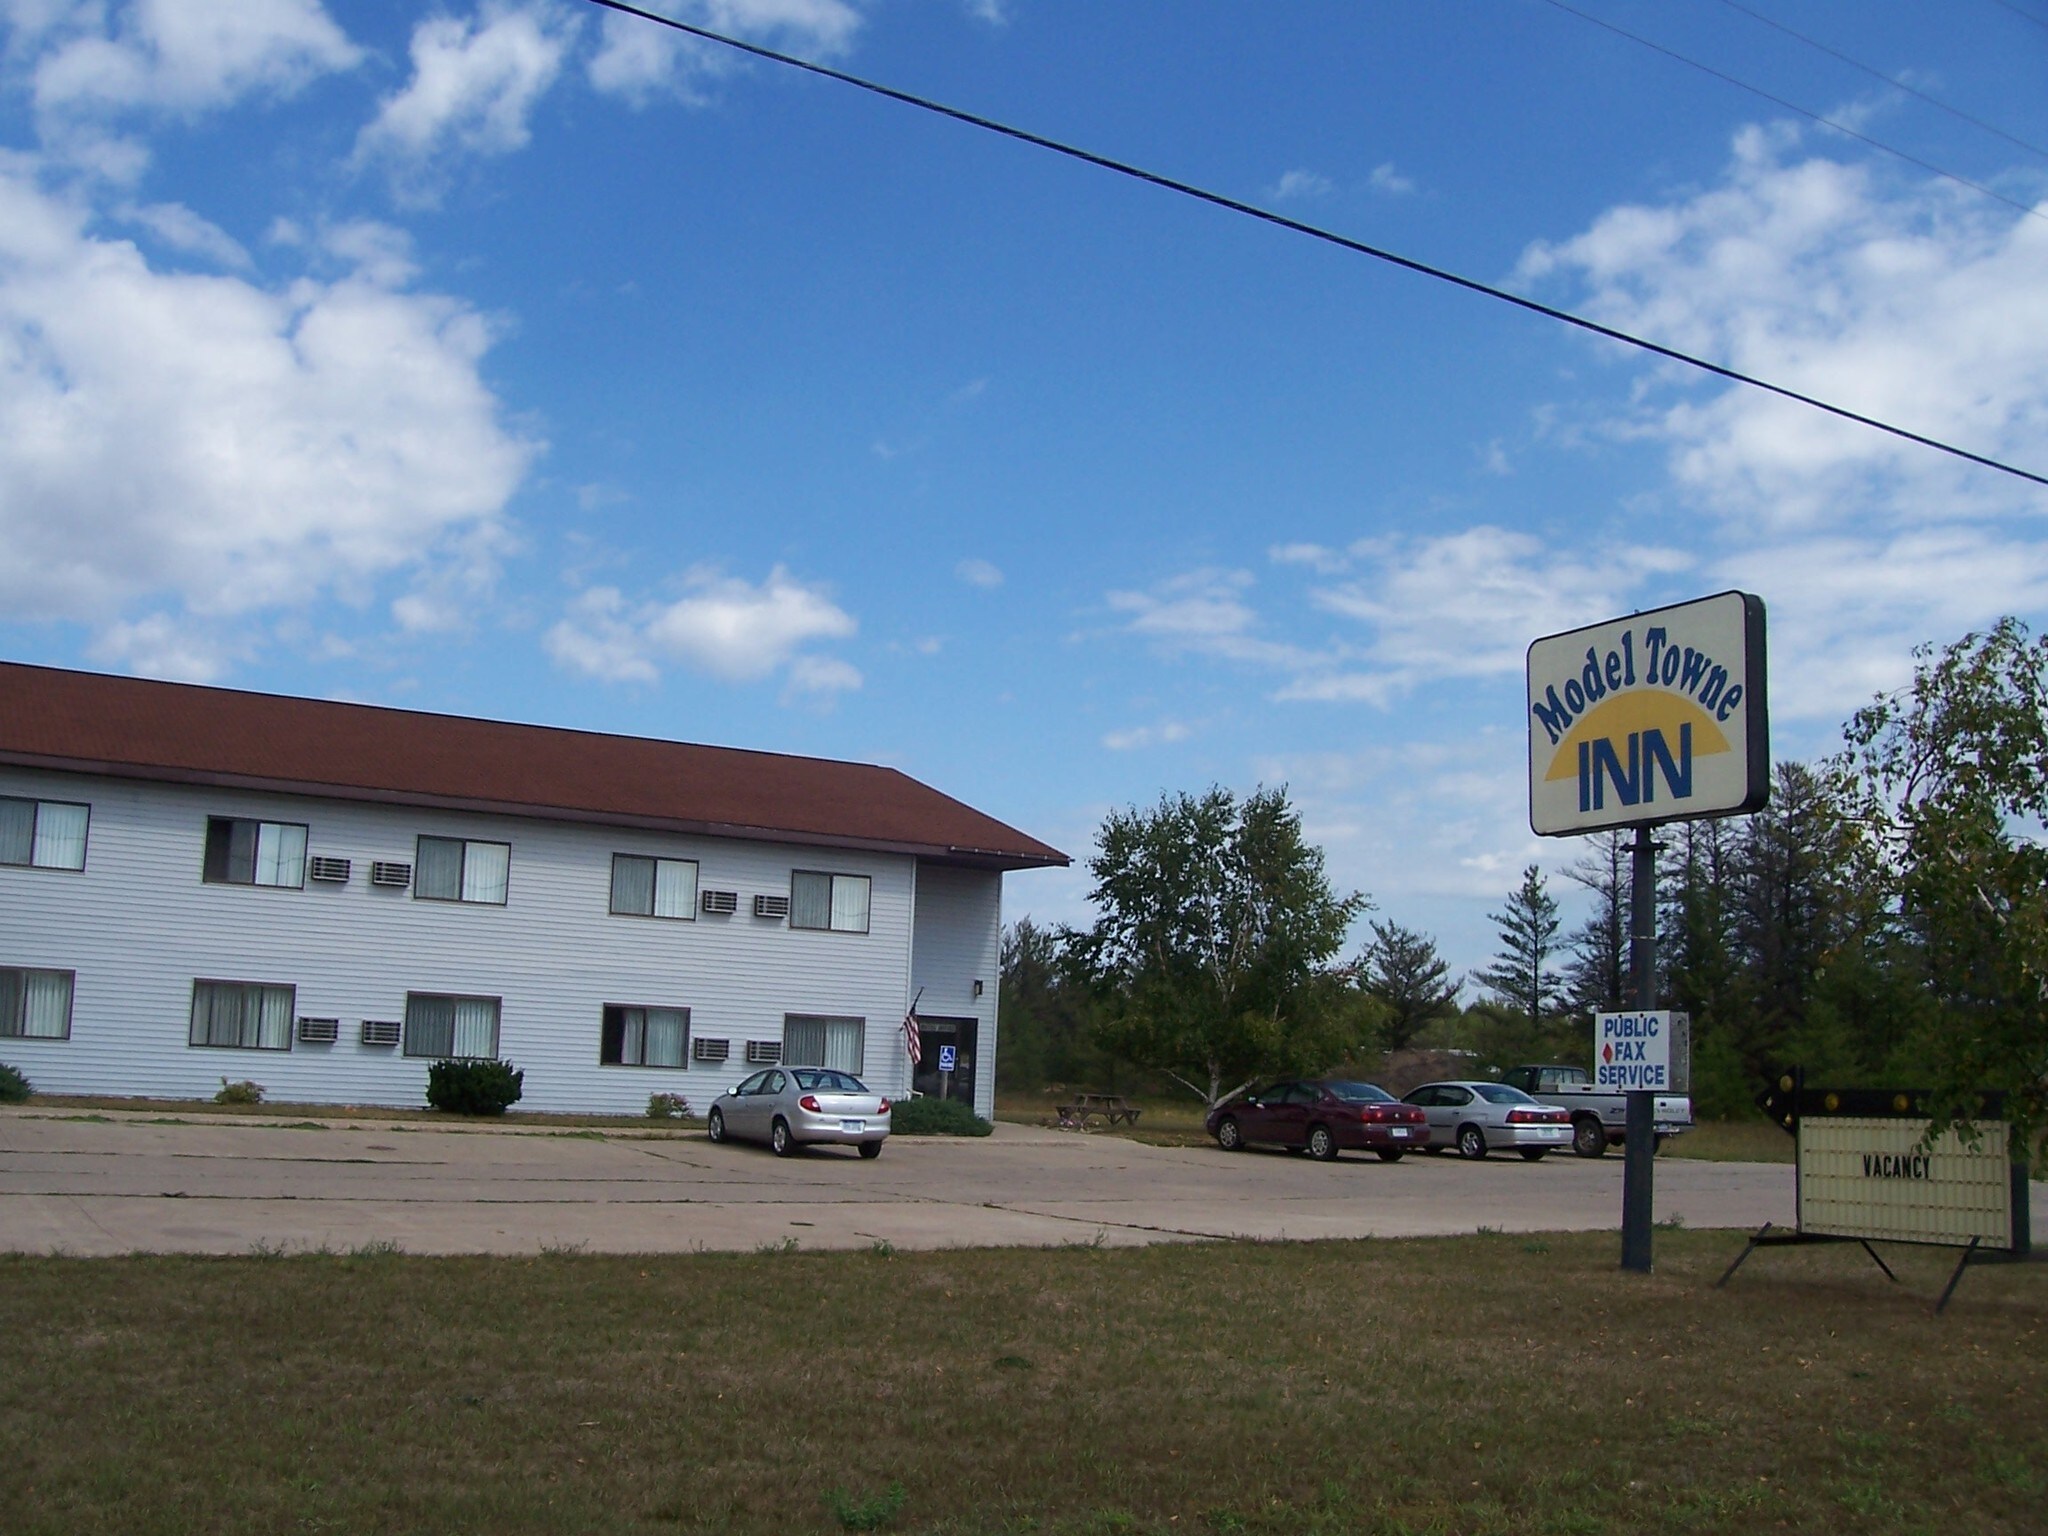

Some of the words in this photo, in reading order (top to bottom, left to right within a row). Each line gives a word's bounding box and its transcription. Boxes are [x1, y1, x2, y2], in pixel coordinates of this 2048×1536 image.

[1532, 630, 1636, 745] Model
[1645, 627, 1743, 722] Towne
[1578, 722, 1692, 812] INN
[1604, 1017, 1659, 1038] PUBLIC
[1615, 1042, 1646, 1061] FAX
[1598, 1065, 1665, 1085] SERVICE
[1863, 1155, 1930, 1179] VACANCY
